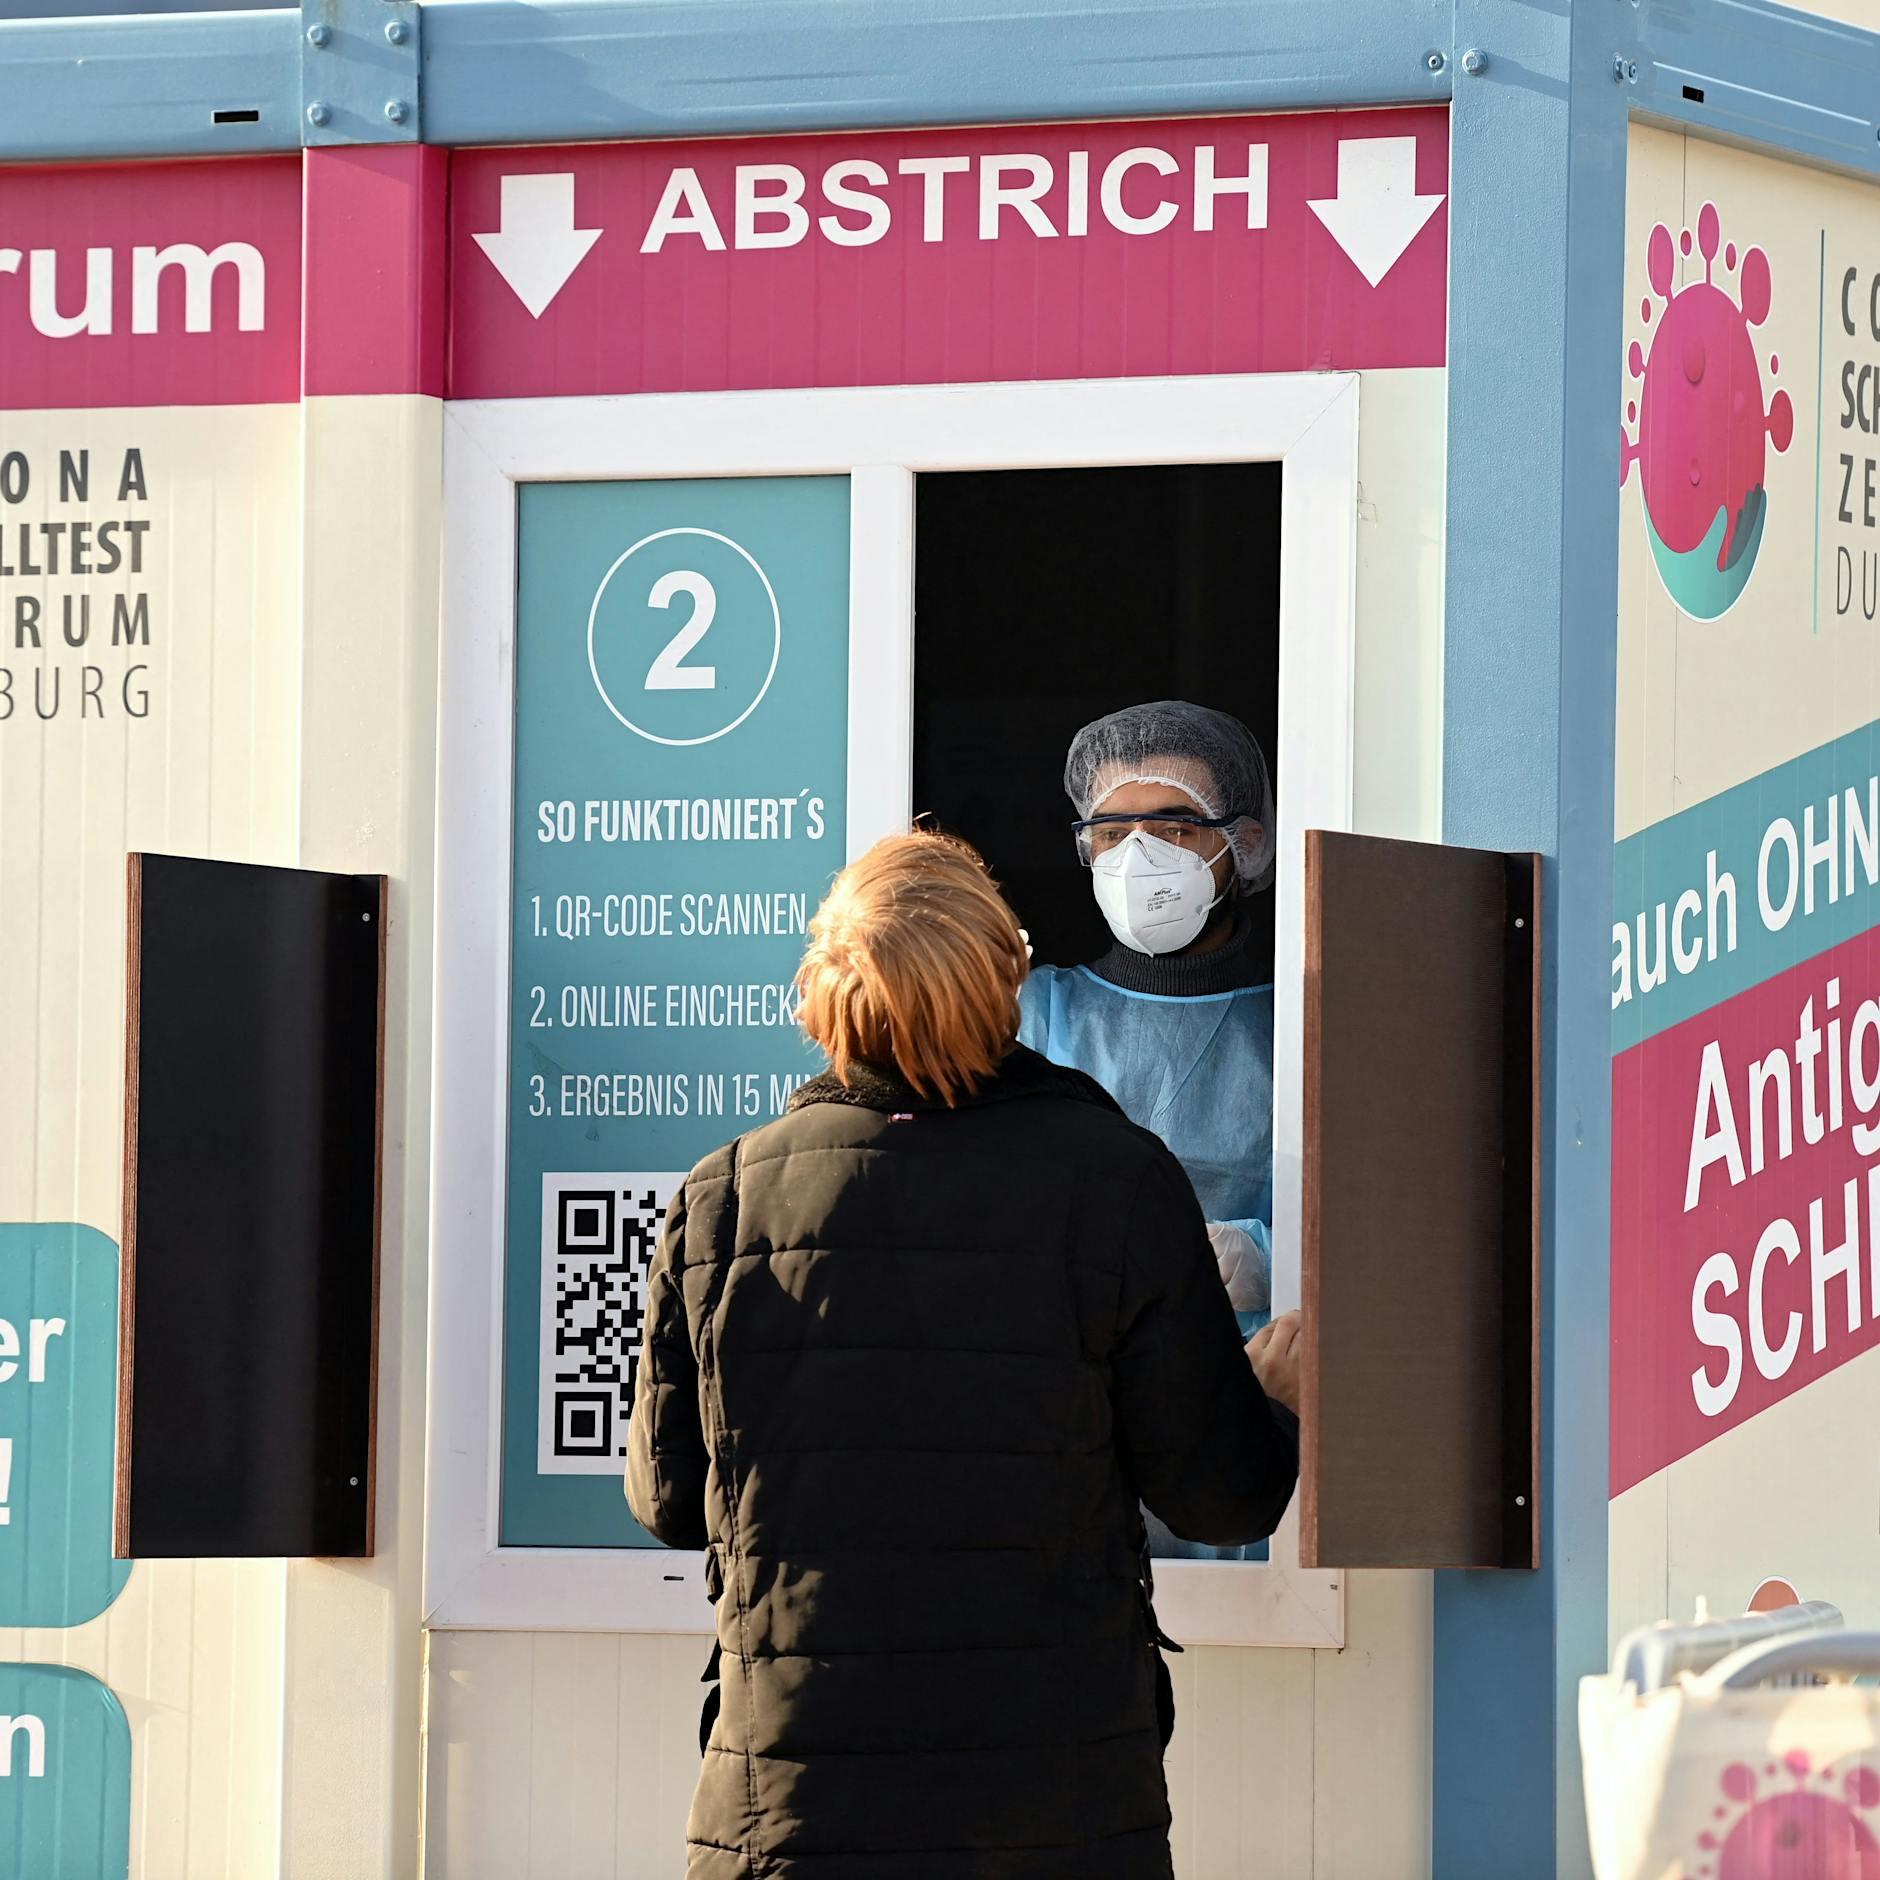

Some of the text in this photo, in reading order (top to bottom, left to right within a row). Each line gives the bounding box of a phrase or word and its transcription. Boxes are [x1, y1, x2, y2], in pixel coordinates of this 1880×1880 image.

[639, 142, 1269, 254] ABSTRICH
[0, 448, 148, 504] ONA
[1838, 453, 1876, 527] ZE
[1837, 546, 1877, 620] DU
[15, 593, 150, 648] RUM
[644, 570, 717, 690] 2
[537, 801, 575, 842] SO
[530, 893, 807, 940] 1. QR-CODE SCANNEN
[1611, 775, 1879, 1010] auch OHN
[529, 985, 552, 1028] 2.
[561, 984, 657, 1027] ONLINE
[529, 1074, 552, 1117] 3.
[560, 1074, 688, 1116] ERGEBNIS
[698, 1073, 722, 1116] IN
[732, 1073, 760, 1115] 15
